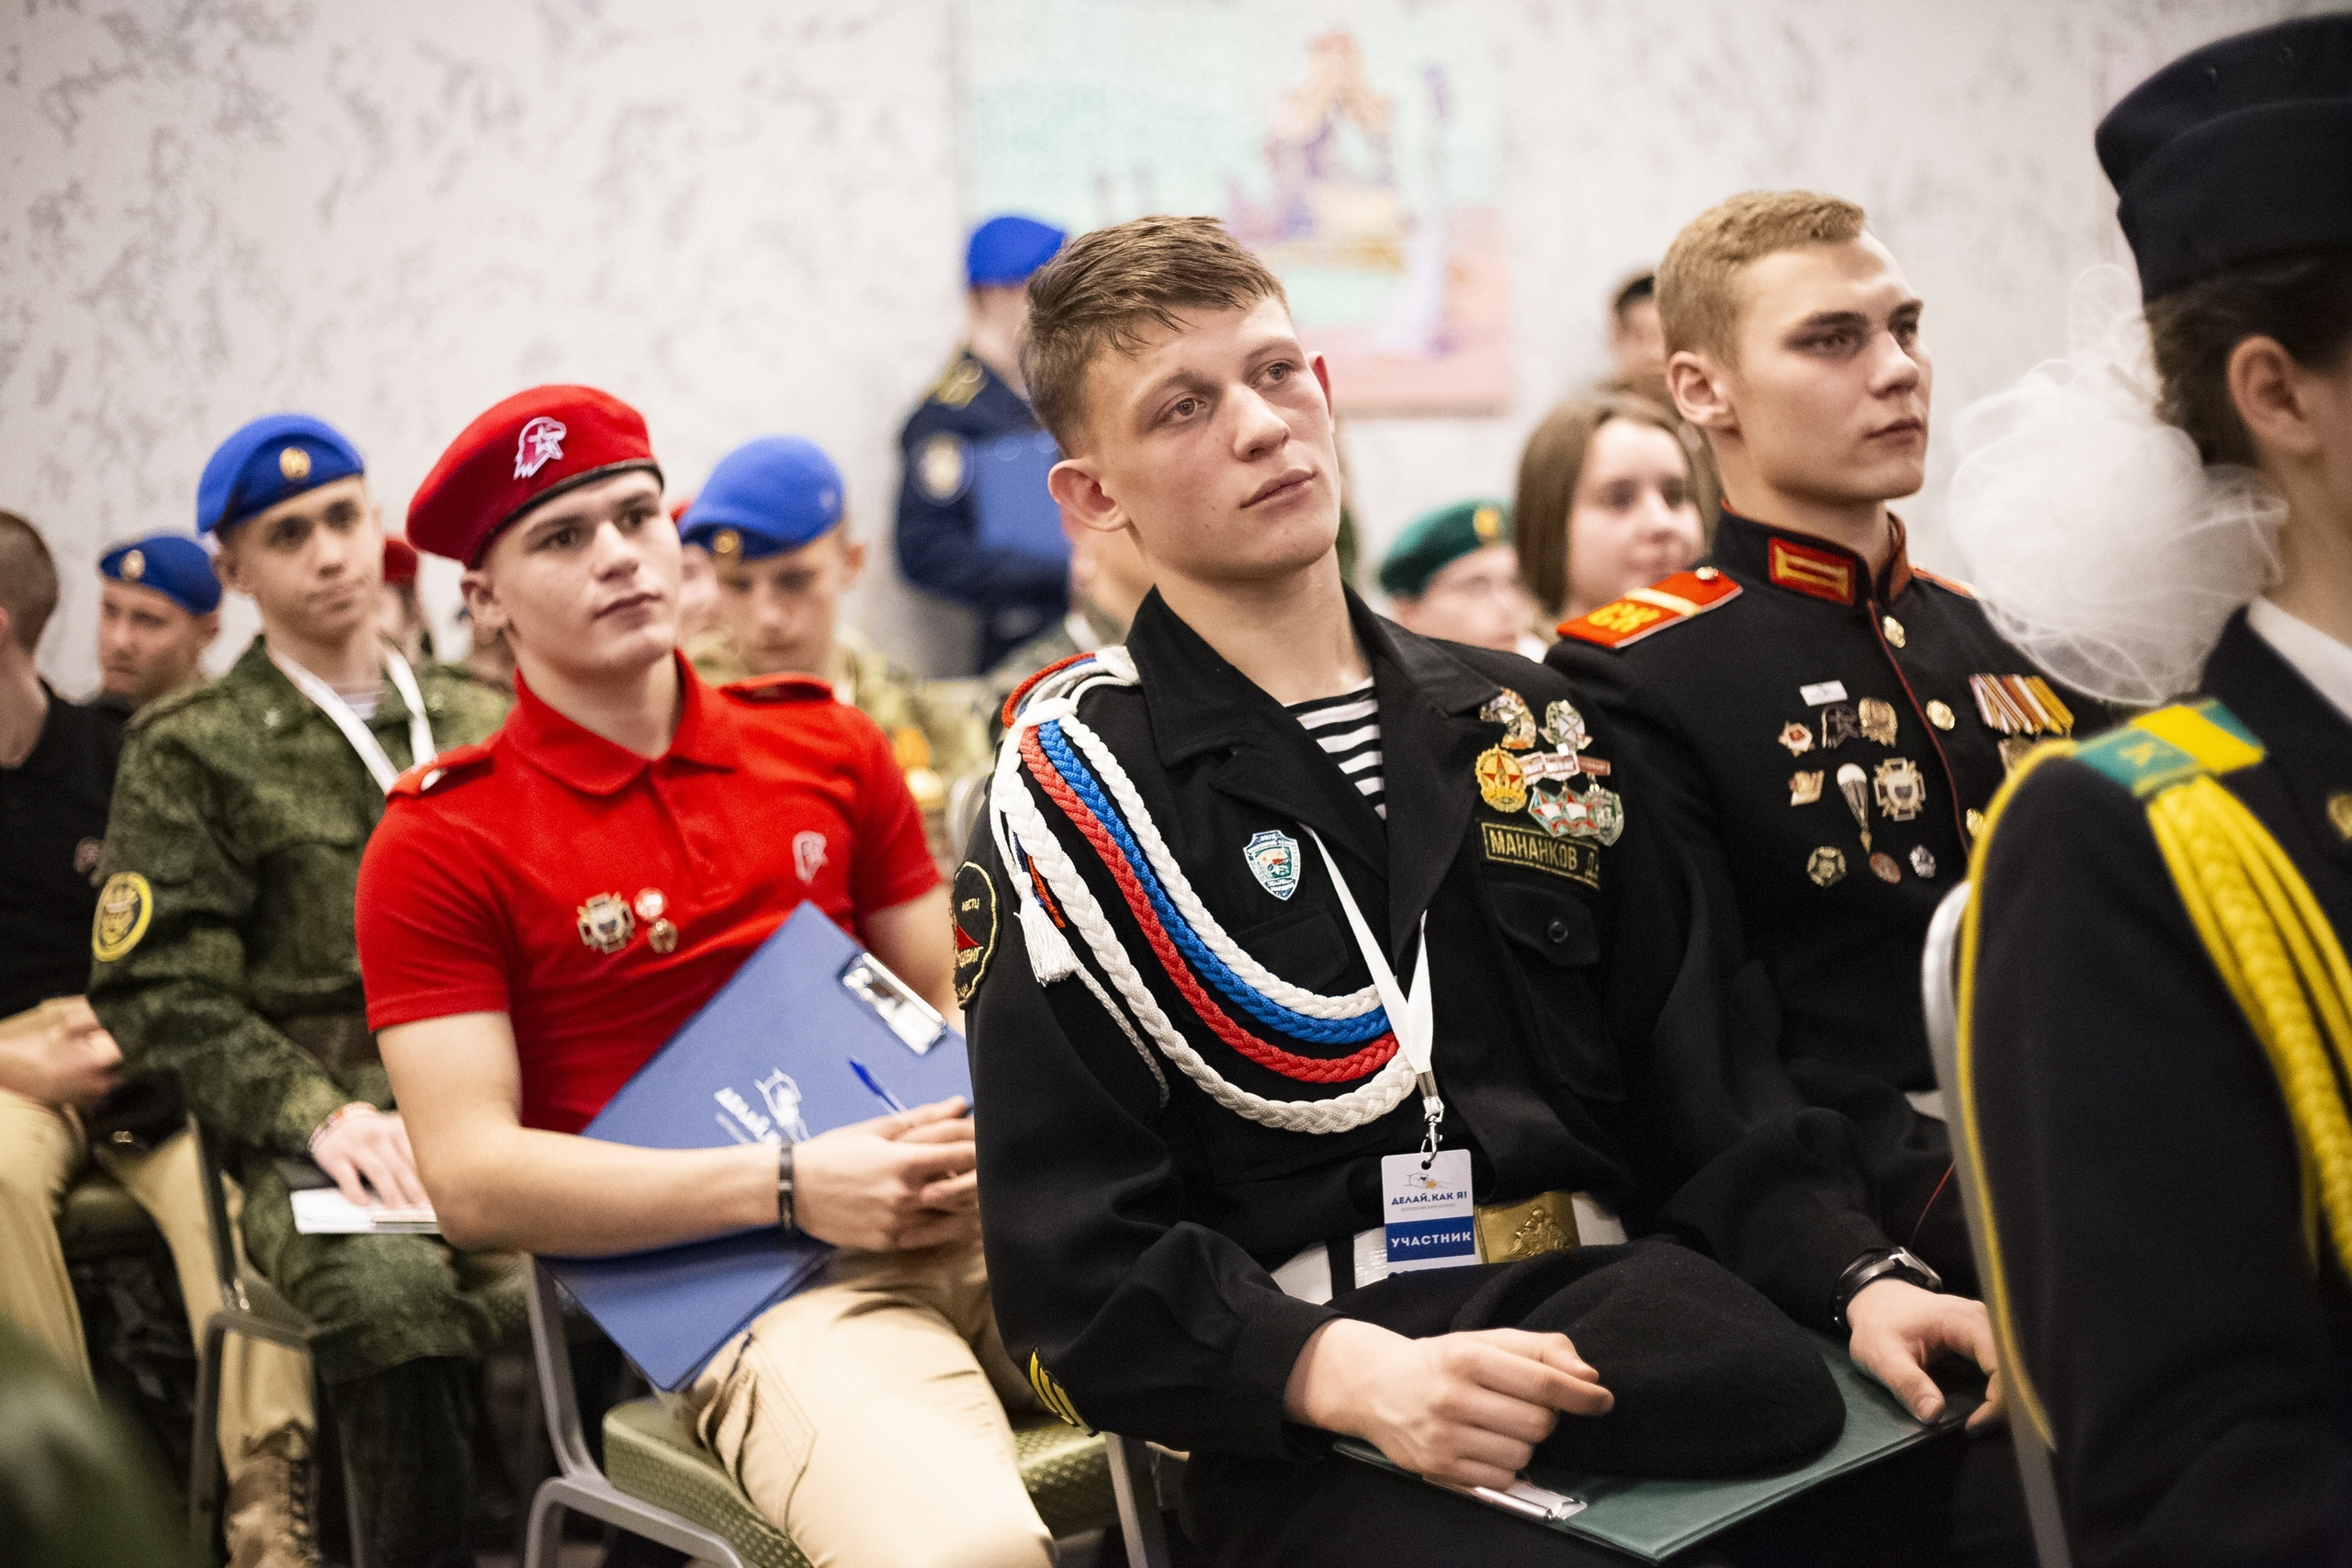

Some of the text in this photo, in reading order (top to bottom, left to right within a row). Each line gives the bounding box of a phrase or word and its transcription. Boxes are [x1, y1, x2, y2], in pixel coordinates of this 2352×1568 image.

[1489, 829, 1577, 871] МАНАНКОВ
[1431, 1192, 1453, 1201] КАК
[1456, 1190, 1467, 1200] Я!
[1391, 1231, 1472, 1248] УЧАСТНИК
